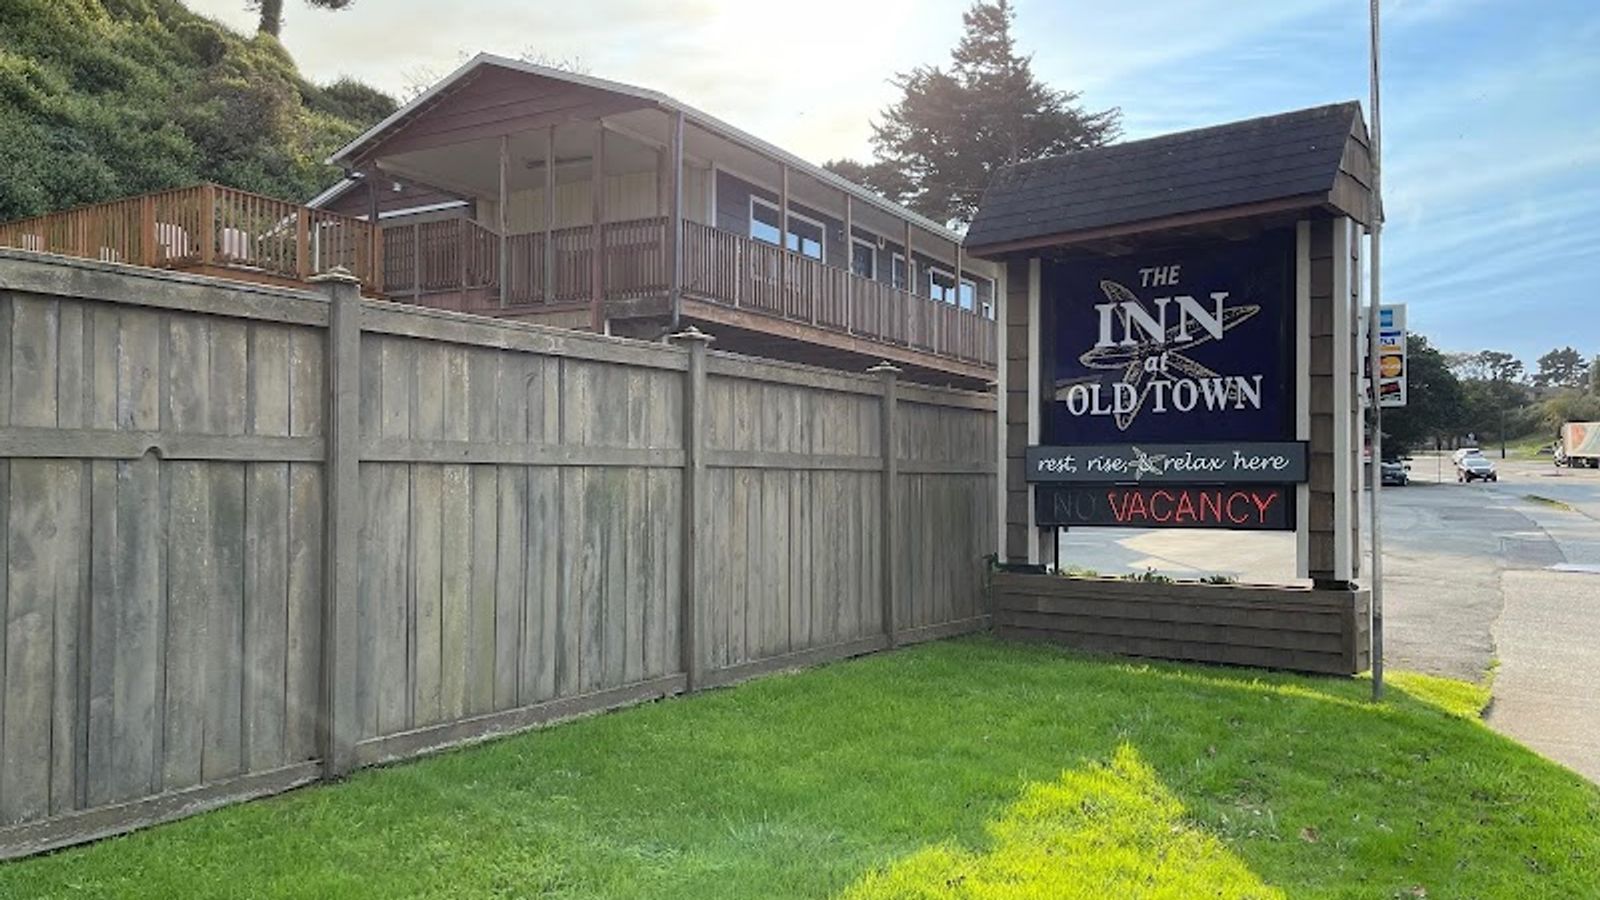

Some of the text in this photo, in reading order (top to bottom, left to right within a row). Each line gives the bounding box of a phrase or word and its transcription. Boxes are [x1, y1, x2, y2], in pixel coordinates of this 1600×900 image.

[1139, 265, 1181, 286] THE
[1094, 292, 1229, 348] INN
[1144, 352, 1168, 372] at
[1066, 375, 1263, 416] OLD TOWN
[1038, 454, 1077, 472] rest,
[1138, 451, 1154, 470] &
[1163, 452, 1226, 471] relax
[1233, 451, 1289, 470] here
[1053, 491, 1278, 524] NO VACANCY
